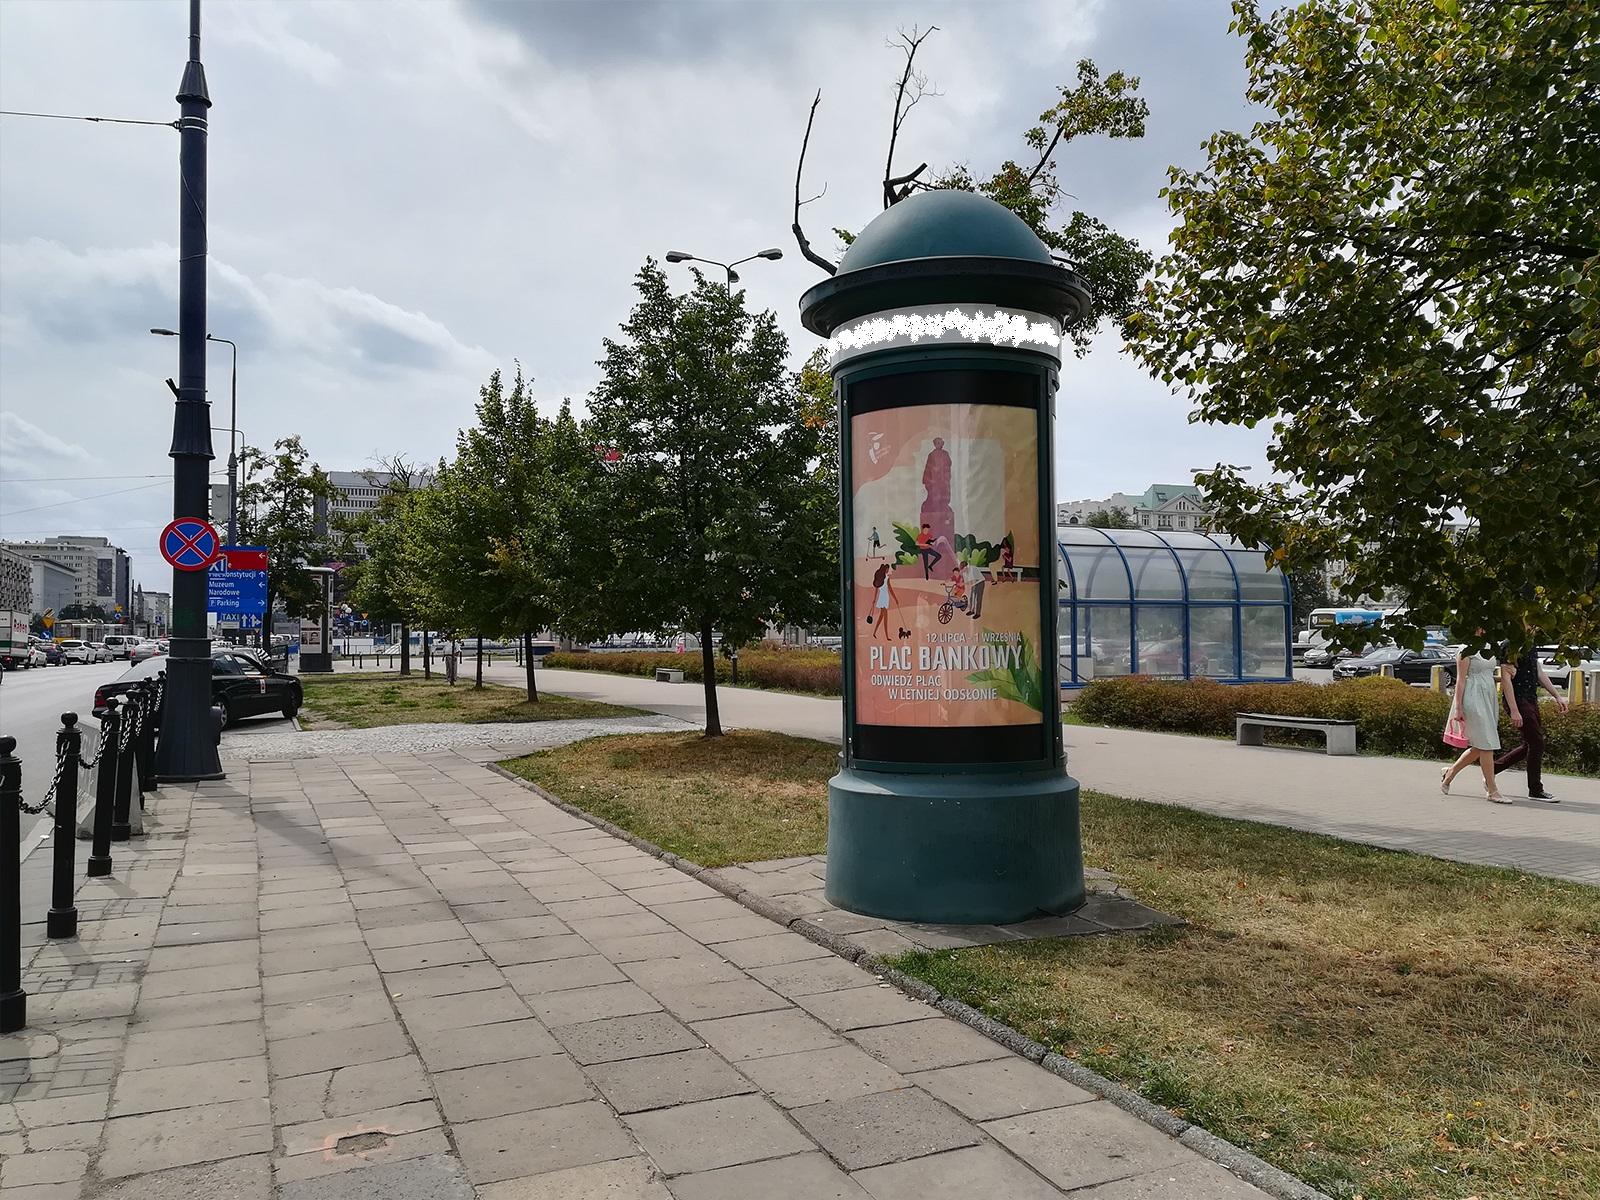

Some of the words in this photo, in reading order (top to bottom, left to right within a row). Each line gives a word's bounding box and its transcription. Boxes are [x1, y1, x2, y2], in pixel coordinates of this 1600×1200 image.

[208, 580, 235, 588] Muzeum
[208, 588, 240, 596] Narodowe
[216, 599, 240, 608] Parking
[222, 613, 240, 621] TAXI
[926, 632, 938, 642] 12
[940, 632, 966, 642] LIPCA
[869, 645, 913, 671] PLAC
[919, 645, 1022, 671] BANKOWY
[871, 673, 913, 686] ODWIEDŹ
[916, 675, 942, 687] PLAC
[888, 688, 898, 700] W
[900, 688, 940, 700] LETNIEJ
[943, 688, 998, 700] ODSŁONIE
